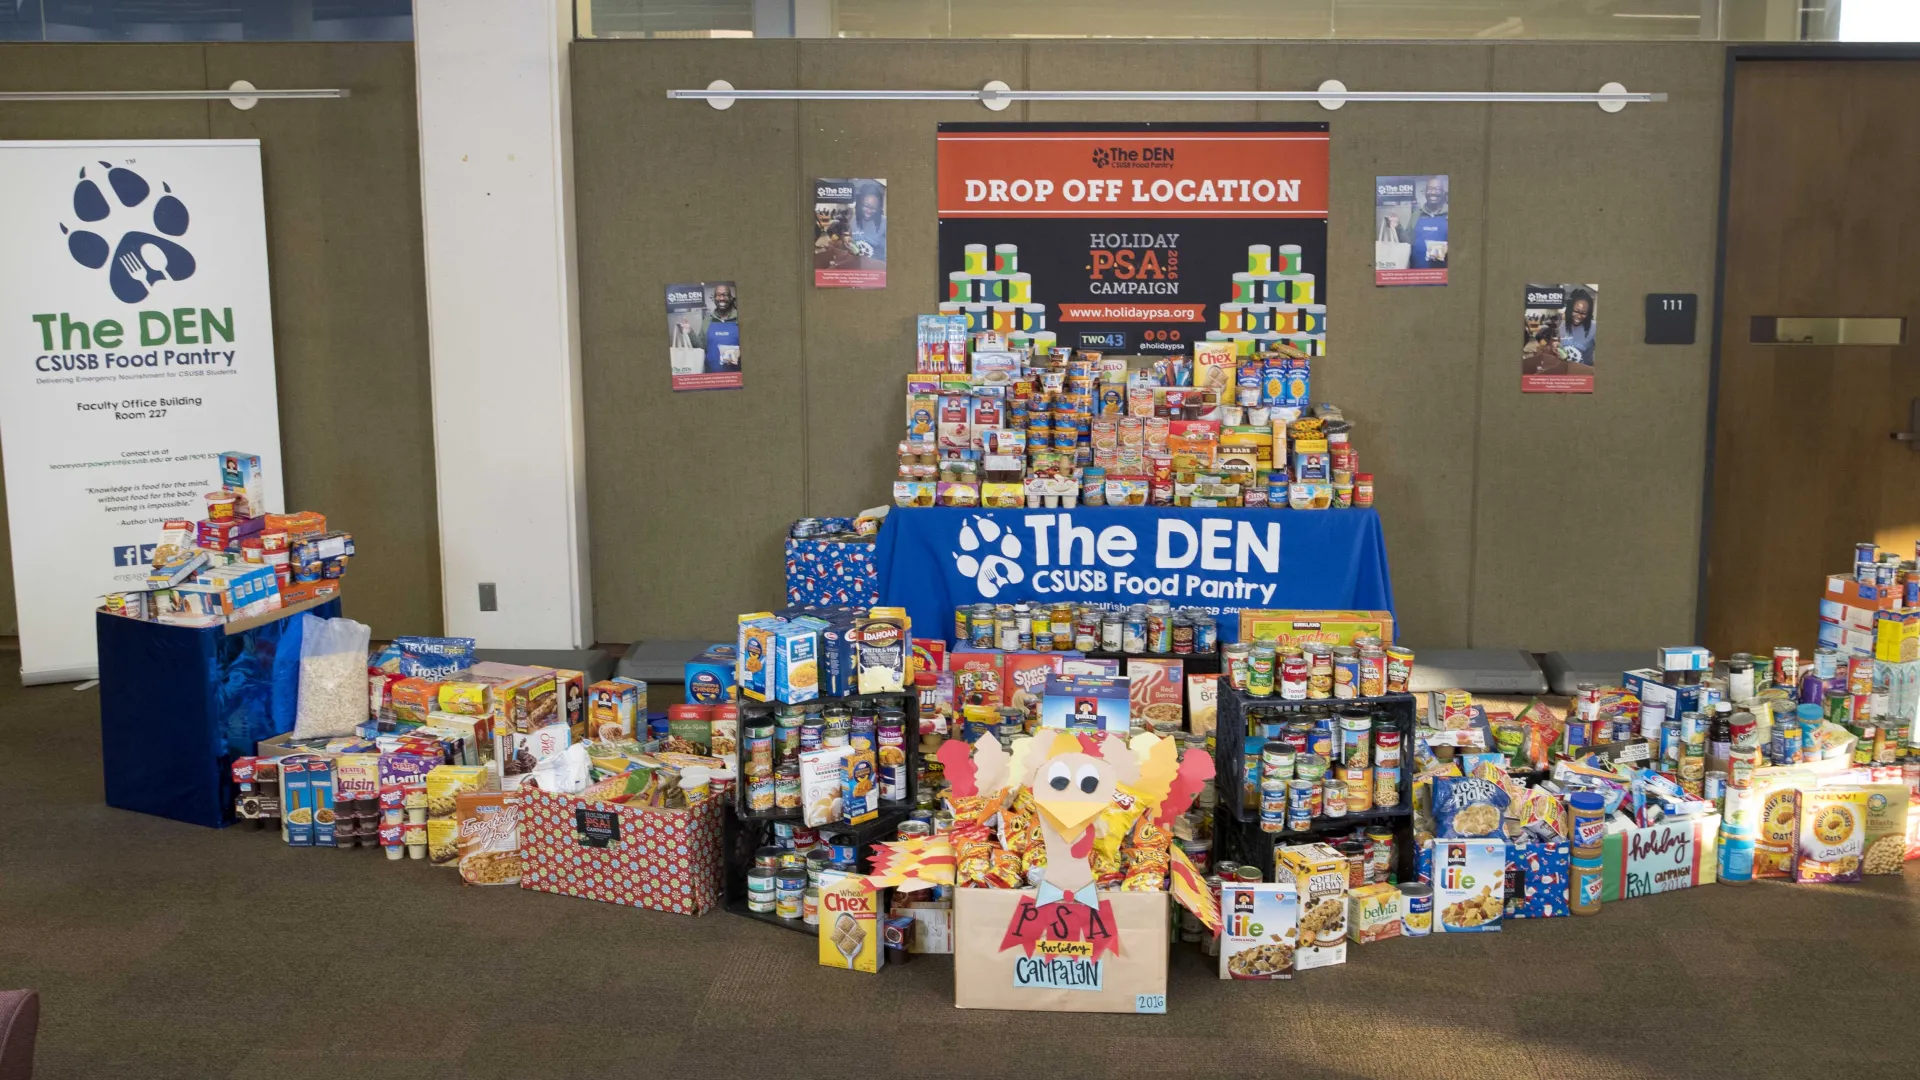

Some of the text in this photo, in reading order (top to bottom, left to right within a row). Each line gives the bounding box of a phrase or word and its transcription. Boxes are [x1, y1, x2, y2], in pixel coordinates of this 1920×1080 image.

[1110, 148, 1174, 161] The DEN
[965, 179, 1301, 202] DROP OFF LOCATION
[1090, 233, 1180, 248] HOLIDAY
[1089, 250, 1165, 280] PSA
[1168, 251, 1179, 279] 2016
[1090, 282, 1179, 294] CAMPAIGN
[1663, 299, 1683, 311] 111
[1070, 307, 1195, 320] www.holidaypsa.org
[33, 307, 235, 350] The DEN
[1140, 343, 1185, 351] @holidaypsa
[35, 349, 236, 372] CSUSB Food Pantry
[1199, 353, 1232, 365] Chex
[36, 377, 74, 385] Delivering
[76, 374, 116, 383] Emergency
[119, 371, 165, 380] Nourishment
[179, 370, 204, 378] CSUSB
[207, 368, 237, 376] Students
[77, 396, 202, 412] Faculty Office Building
[115, 409, 167, 421] Room 227
[121, 450, 150, 458] Contact
[142, 482, 160, 490] food
[188, 480, 209, 488] mind,
[130, 494, 149, 502] food
[177, 490, 198, 499] body,
[105, 504, 138, 513] learning
[121, 518, 147, 526] Author
[1025, 513, 1281, 573] The DEN
[1032, 570, 1277, 605] CSUSB Food Pantry
[864, 630, 898, 641] IDAHOAN
[1277, 632, 1340, 646] Peaches
[405, 643, 422, 652] TRY
[424, 645, 443, 654] ME!
[412, 662, 458, 677] Frosted
[1014, 665, 1052, 686] Snack
[960, 671, 995, 684] FROOT
[965, 681, 997, 692] LOOPS
[920, 690, 936, 704] Jif
[585, 811, 610, 820] HOLIDAY
[1762, 797, 1779, 822] HONEY
[1817, 811, 1830, 828] HONEY
[1629, 828, 1690, 864] holiday
[1819, 839, 1860, 859] CRUNCH!
[1310, 873, 1343, 883] SOFT &
[1441, 868, 1475, 889] life
[1655, 866, 1691, 883] CAMPAIGN
[1308, 880, 1344, 893] CHEWY
[824, 893, 871, 912] Chex
[1227, 915, 1264, 937] life
[1038, 940, 1091, 956] holiday
[1139, 996, 1164, 1009] 2016
